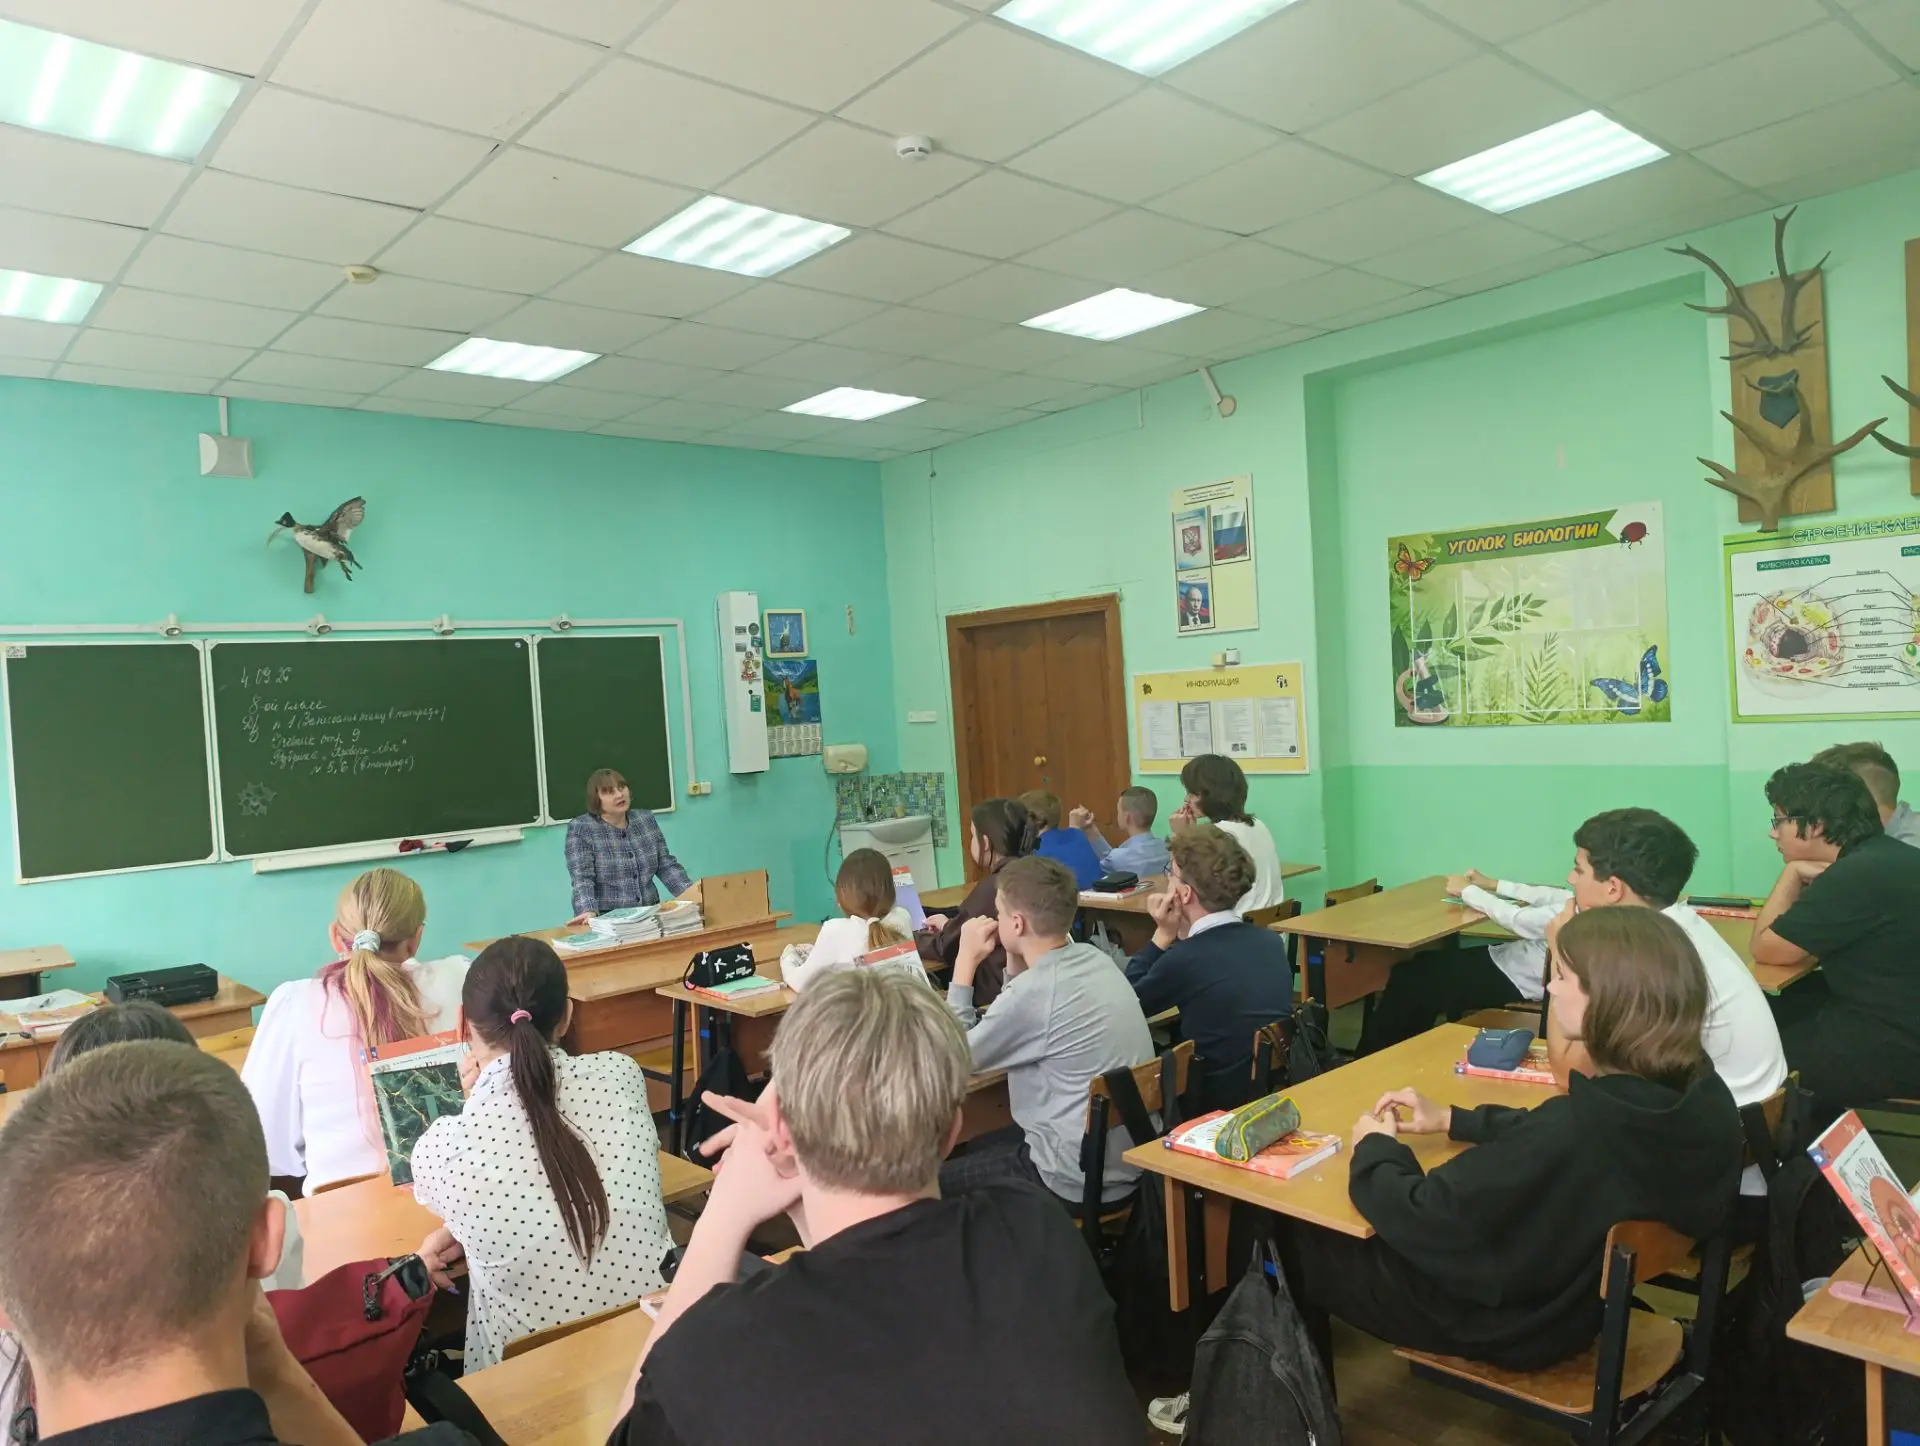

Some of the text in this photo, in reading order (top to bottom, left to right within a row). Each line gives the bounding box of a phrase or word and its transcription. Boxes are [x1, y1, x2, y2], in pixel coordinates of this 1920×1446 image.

[1448, 522, 1600, 556] УГОЛОК БИОЛОГИИ
[1793, 522, 1877, 542] СТРОЕНИЕ
[1758, 555, 1829, 570] ЖИВОТНАЯ КЛЕТКА
[1186, 677, 1240, 689] ИНФОРМАЦИЯ
